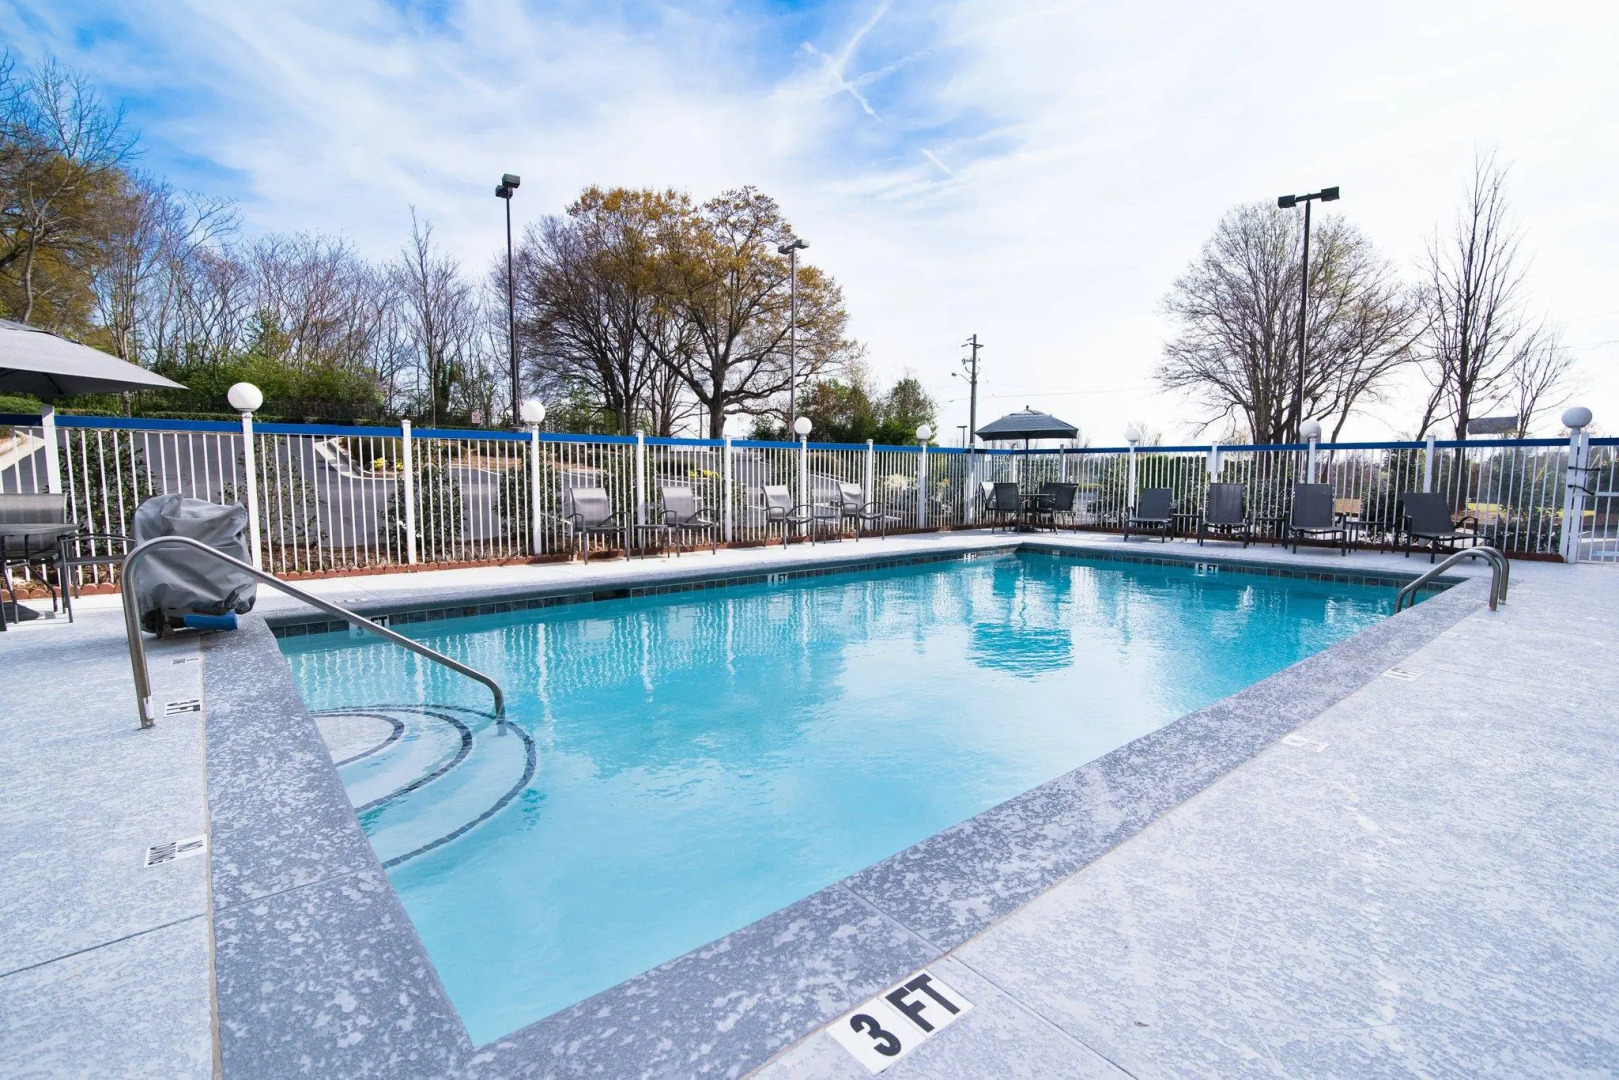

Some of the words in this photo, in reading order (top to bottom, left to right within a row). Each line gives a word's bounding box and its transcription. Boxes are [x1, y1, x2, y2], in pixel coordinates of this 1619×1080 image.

[1207, 564, 1217, 574] FT
[165, 704, 201, 716] FT
[850, 1013, 902, 1057] 3
[885, 973, 961, 1033] FT
